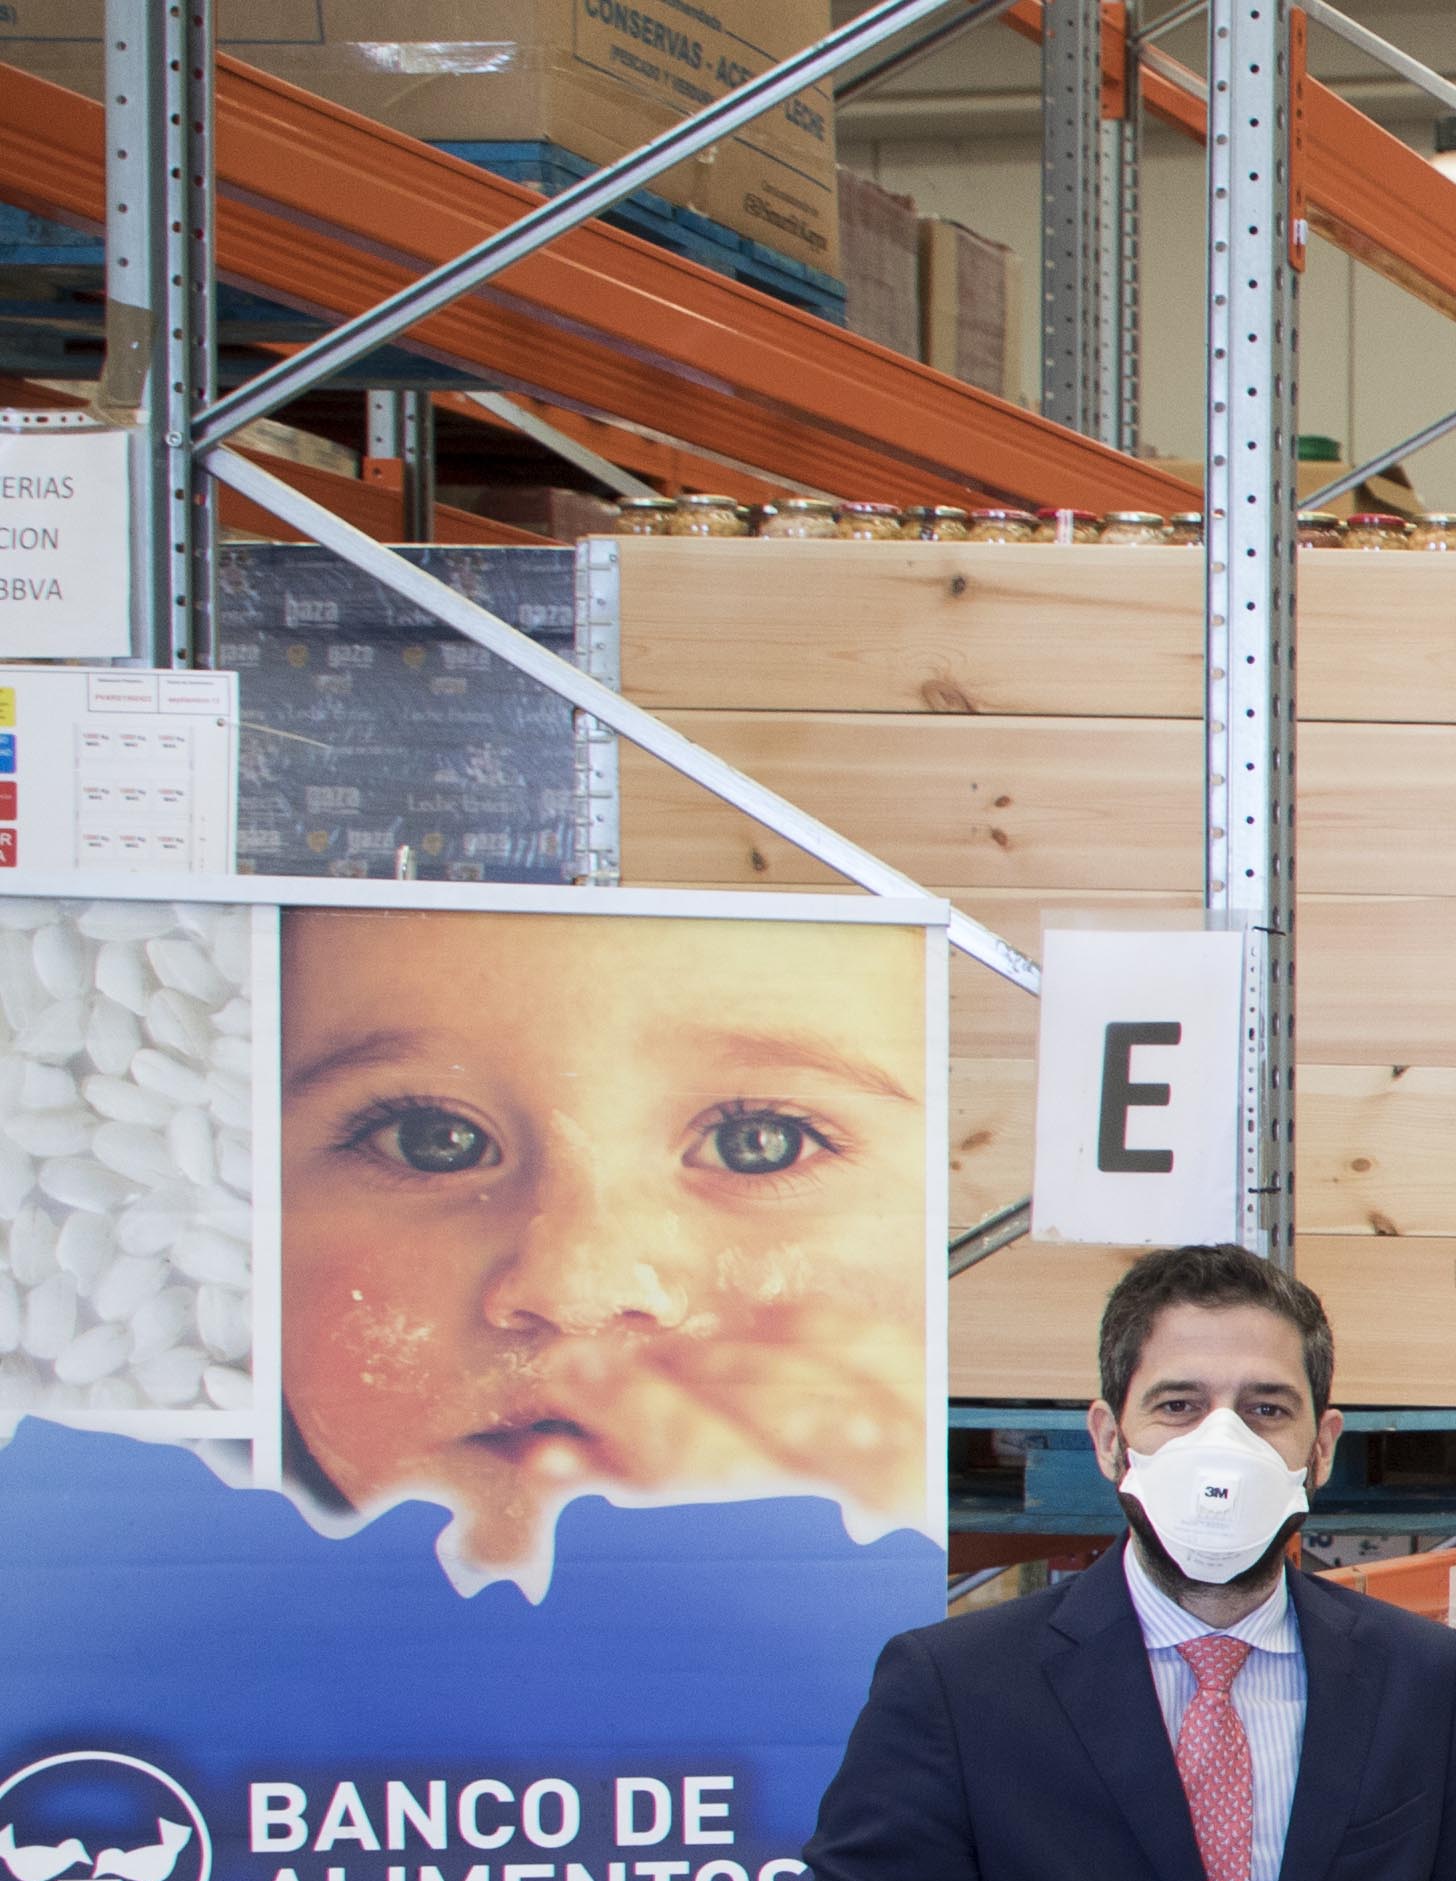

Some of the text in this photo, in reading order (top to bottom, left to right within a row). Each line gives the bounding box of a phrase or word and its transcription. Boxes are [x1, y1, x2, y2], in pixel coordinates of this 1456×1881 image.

[1097, 1021, 1182, 1174] E
[1205, 1486, 1229, 1500] 3M
[249, 1774, 737, 1854] BANCO DE
